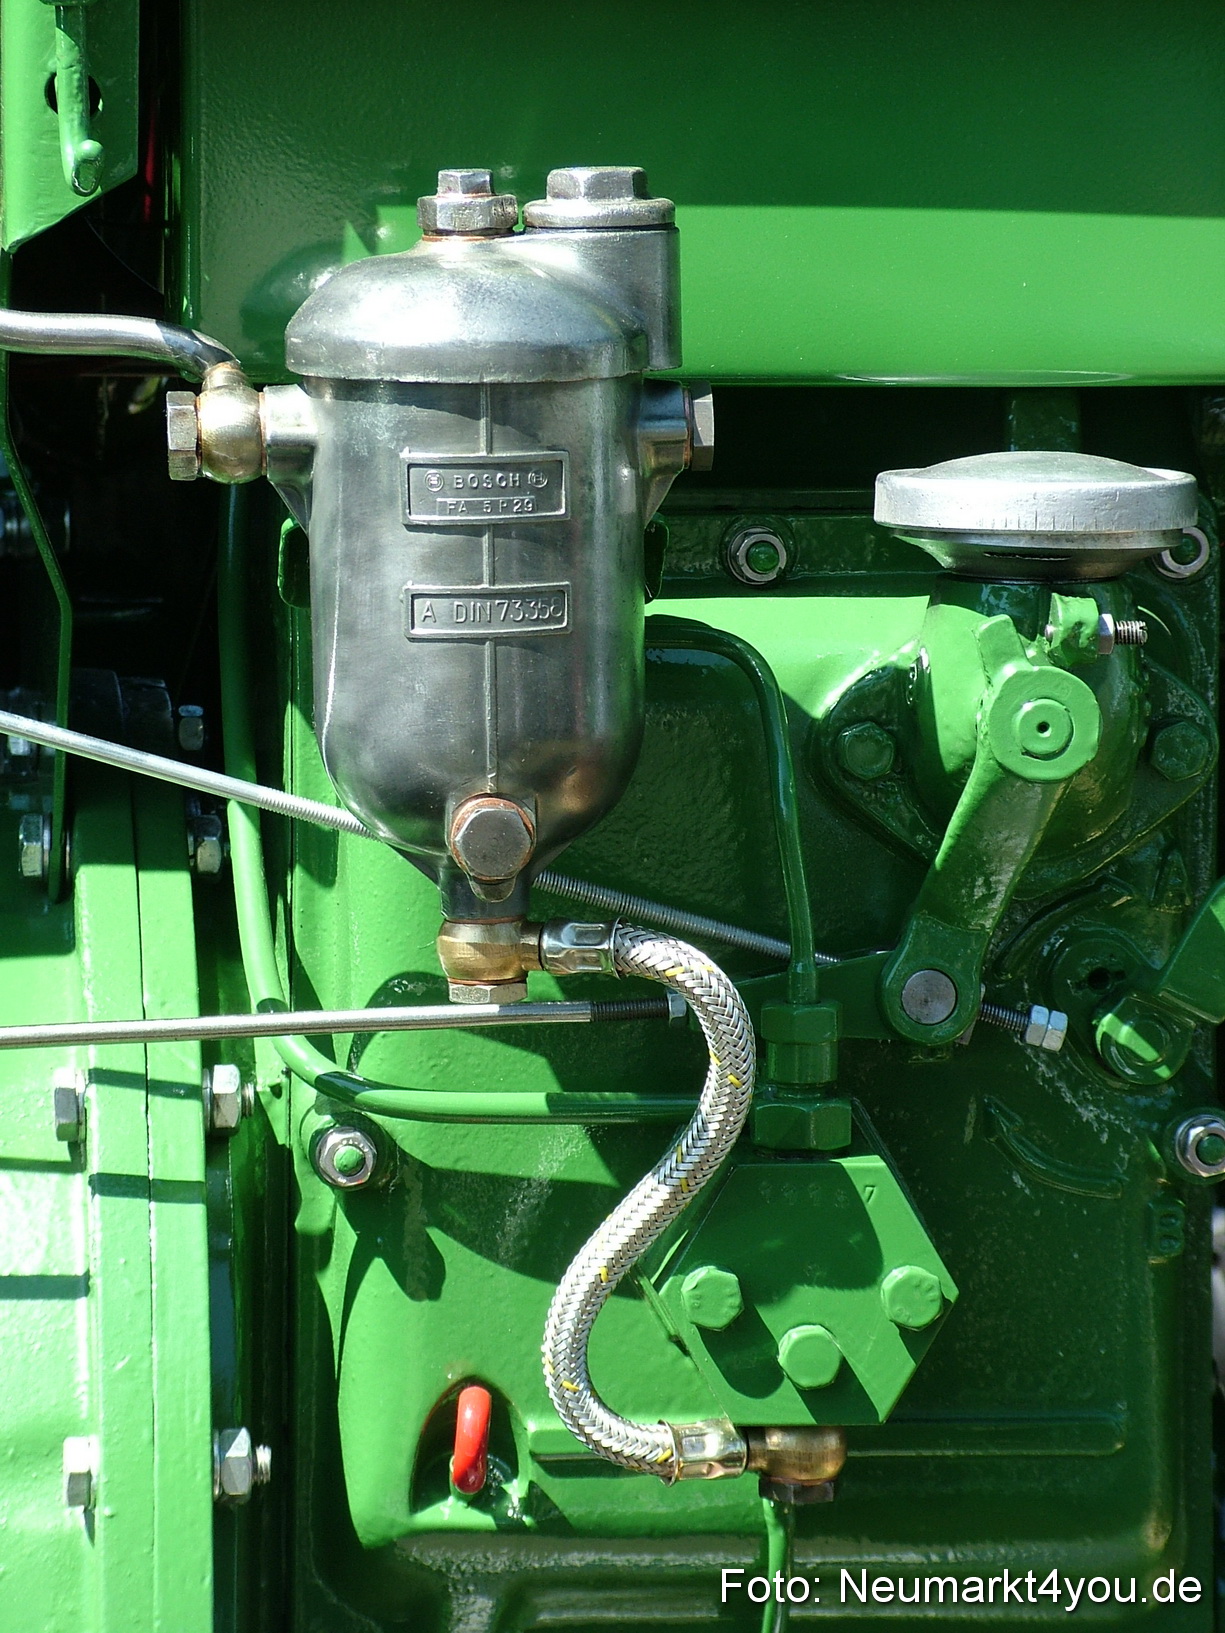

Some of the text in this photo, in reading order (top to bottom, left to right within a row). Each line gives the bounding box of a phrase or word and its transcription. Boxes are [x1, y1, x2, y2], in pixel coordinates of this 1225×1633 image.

[453, 472, 520, 490] BOSCH
[446, 500, 468, 515] FA
[421, 600, 437, 623] A
